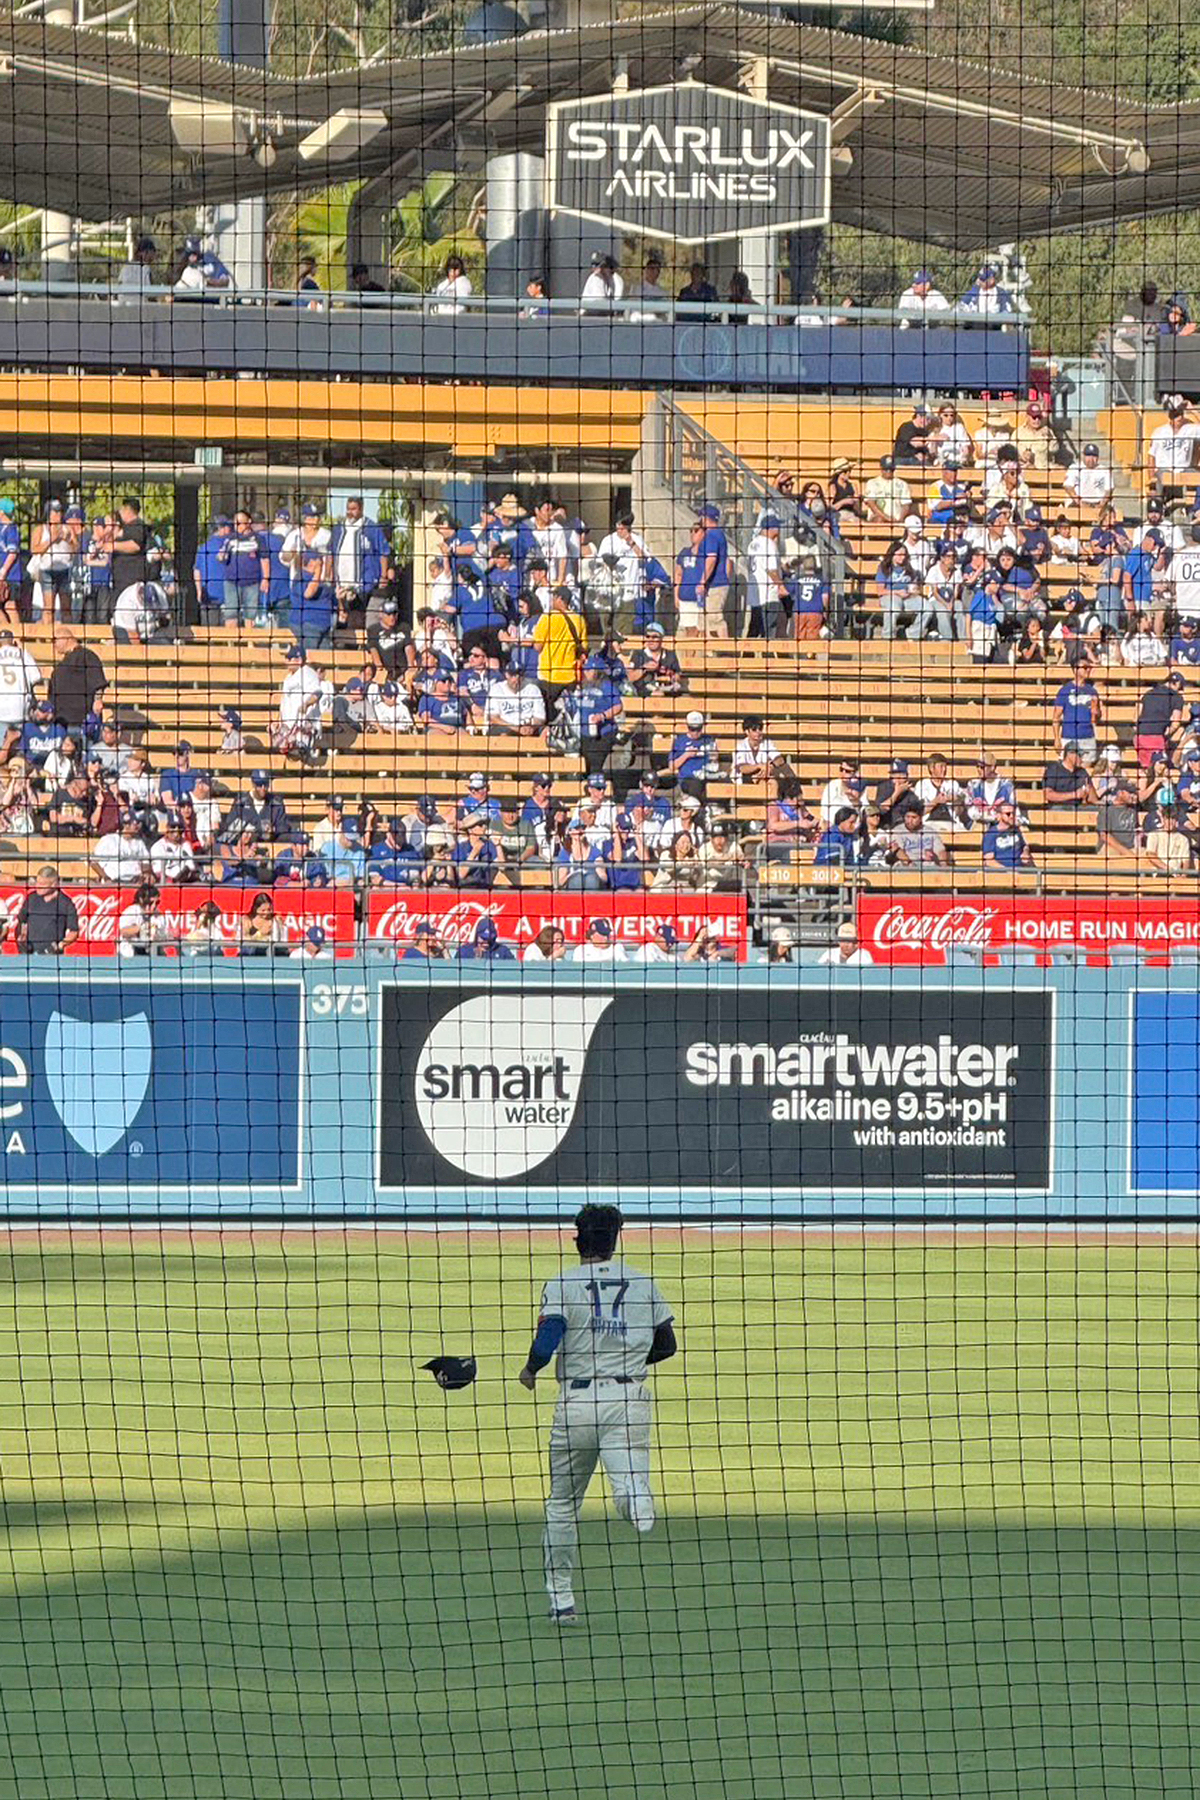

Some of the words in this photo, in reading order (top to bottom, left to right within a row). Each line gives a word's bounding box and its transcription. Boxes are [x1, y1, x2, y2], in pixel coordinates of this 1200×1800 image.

[567, 121, 815, 169] STARLUX
[605, 168, 777, 201] AIRLINES
[801, 585, 813, 601] 5
[771, 870, 791, 881] 310
[284, 912, 338, 931] AGIC
[514, 916, 534, 936] A
[539, 915, 582, 936] HIT
[677, 915, 741, 937] TIME
[1005, 919, 1074, 940] HOME
[1080, 920, 1127, 940] RUN
[1135, 921, 1200, 941] MAGIC
[311, 984, 369, 1015] 375
[685, 1034, 1019, 1087] smartwater
[423, 1056, 570, 1099] smart
[505, 1103, 570, 1124] water
[771, 1090, 891, 1121] alkaline
[897, 1091, 1007, 1127] 9.5+pH
[853, 1127, 896, 1146] with
[898, 1127, 1006, 1147] antioxidant
[584, 1281, 630, 1318] 17
